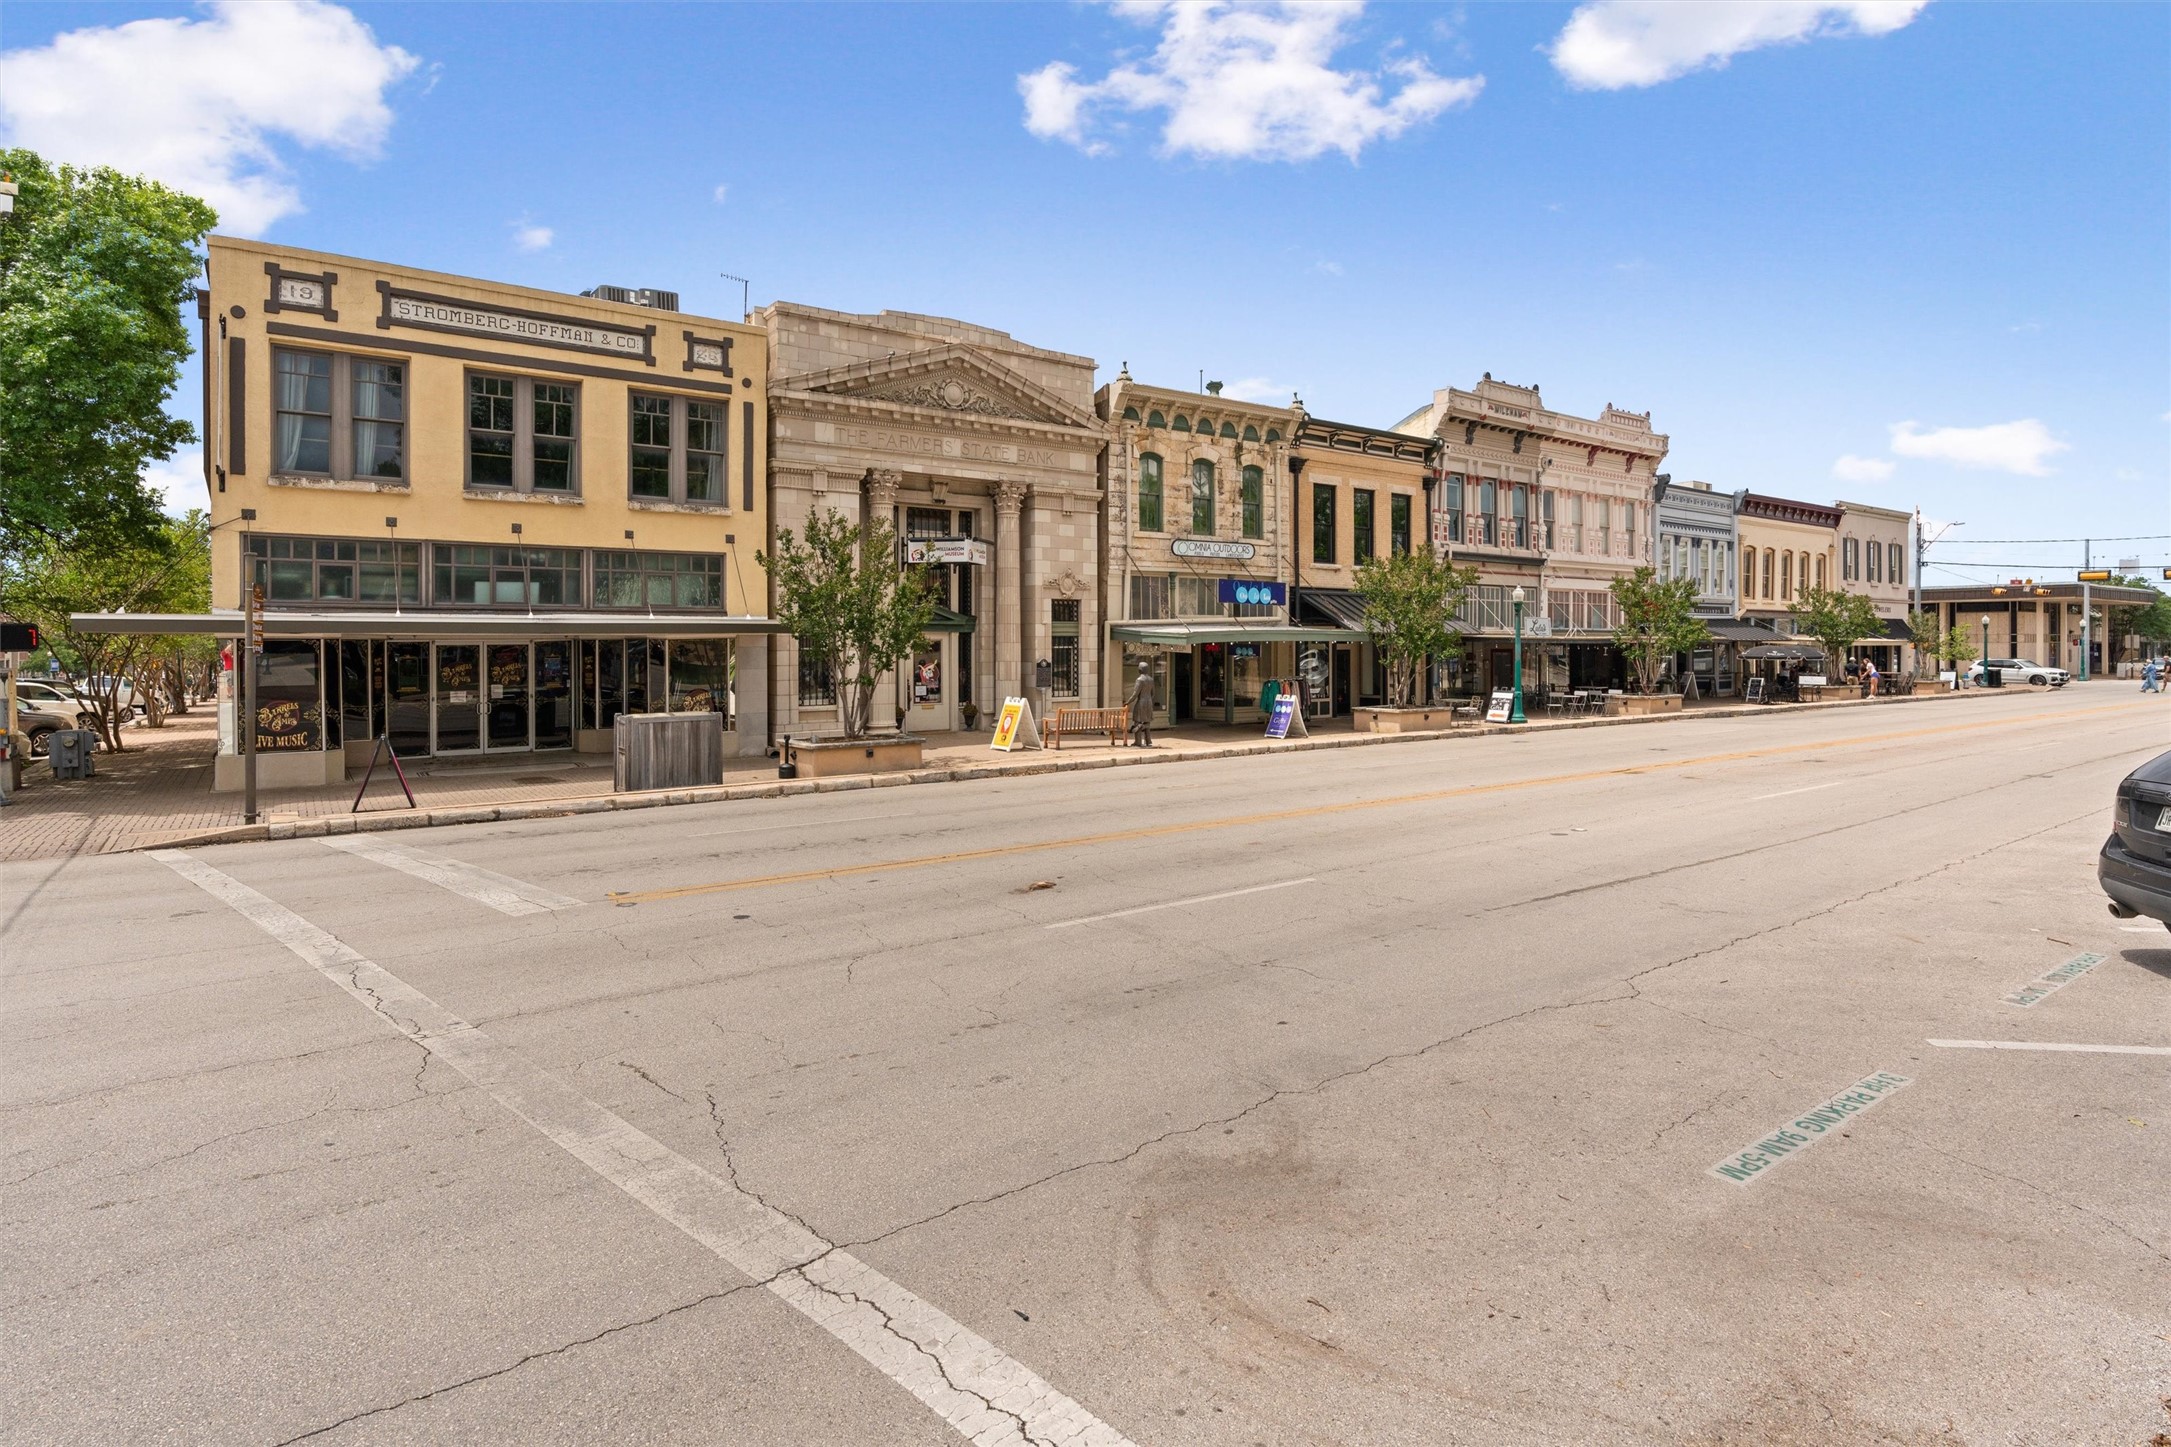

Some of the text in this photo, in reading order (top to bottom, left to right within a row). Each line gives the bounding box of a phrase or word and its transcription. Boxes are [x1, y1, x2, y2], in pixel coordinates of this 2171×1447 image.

[289, 284, 313, 300] 19
[398, 301, 594, 343] STROMBERG-HOFFMAN
[600, 334, 611, 346] &
[835, 427, 869, 444] THE
[960, 441, 1012, 462] STATE
[1017, 448, 1056, 465] BANK
[1188, 542, 1251, 555] OMNIA OUTDOORS
[28, 628, 36, 646] 7
[258, 702, 299, 723] BARRELS
[276, 731, 308, 747] MUSIC
[1794, 1089, 1877, 1133] PARKING
[1715, 1130, 1808, 1182] 9AM-5PM
